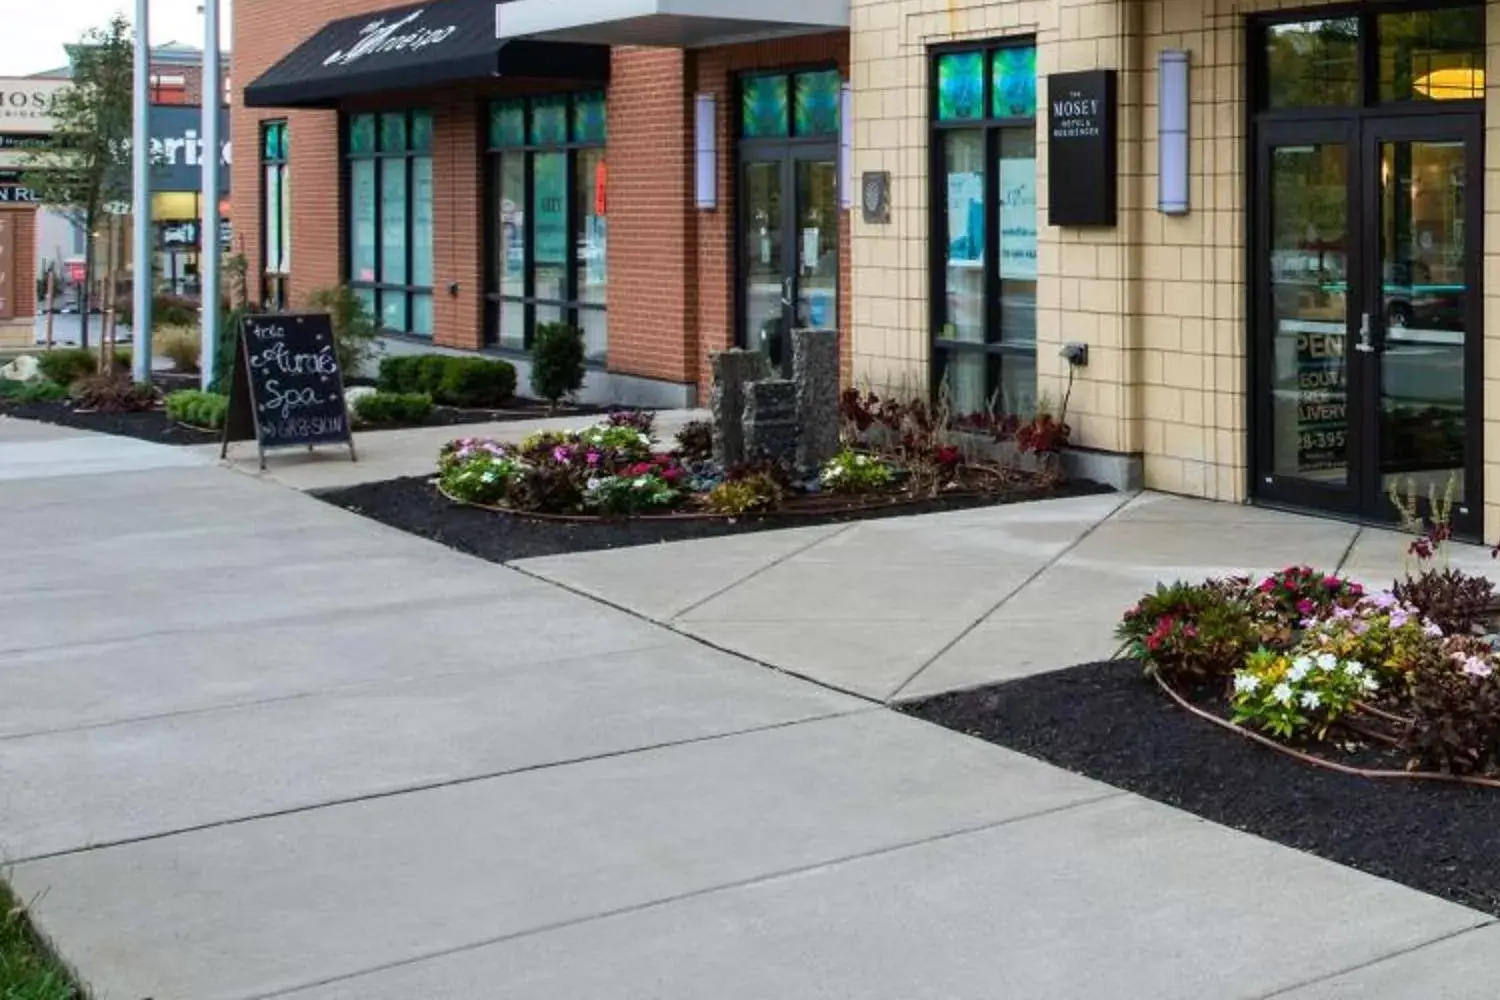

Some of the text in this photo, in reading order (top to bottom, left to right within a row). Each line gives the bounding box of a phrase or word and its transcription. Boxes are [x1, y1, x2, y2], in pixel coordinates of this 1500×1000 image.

[1053, 99, 1099, 118] MOSEY
[1296, 332, 1343, 359] PEN
[265, 379, 324, 419] Spa
